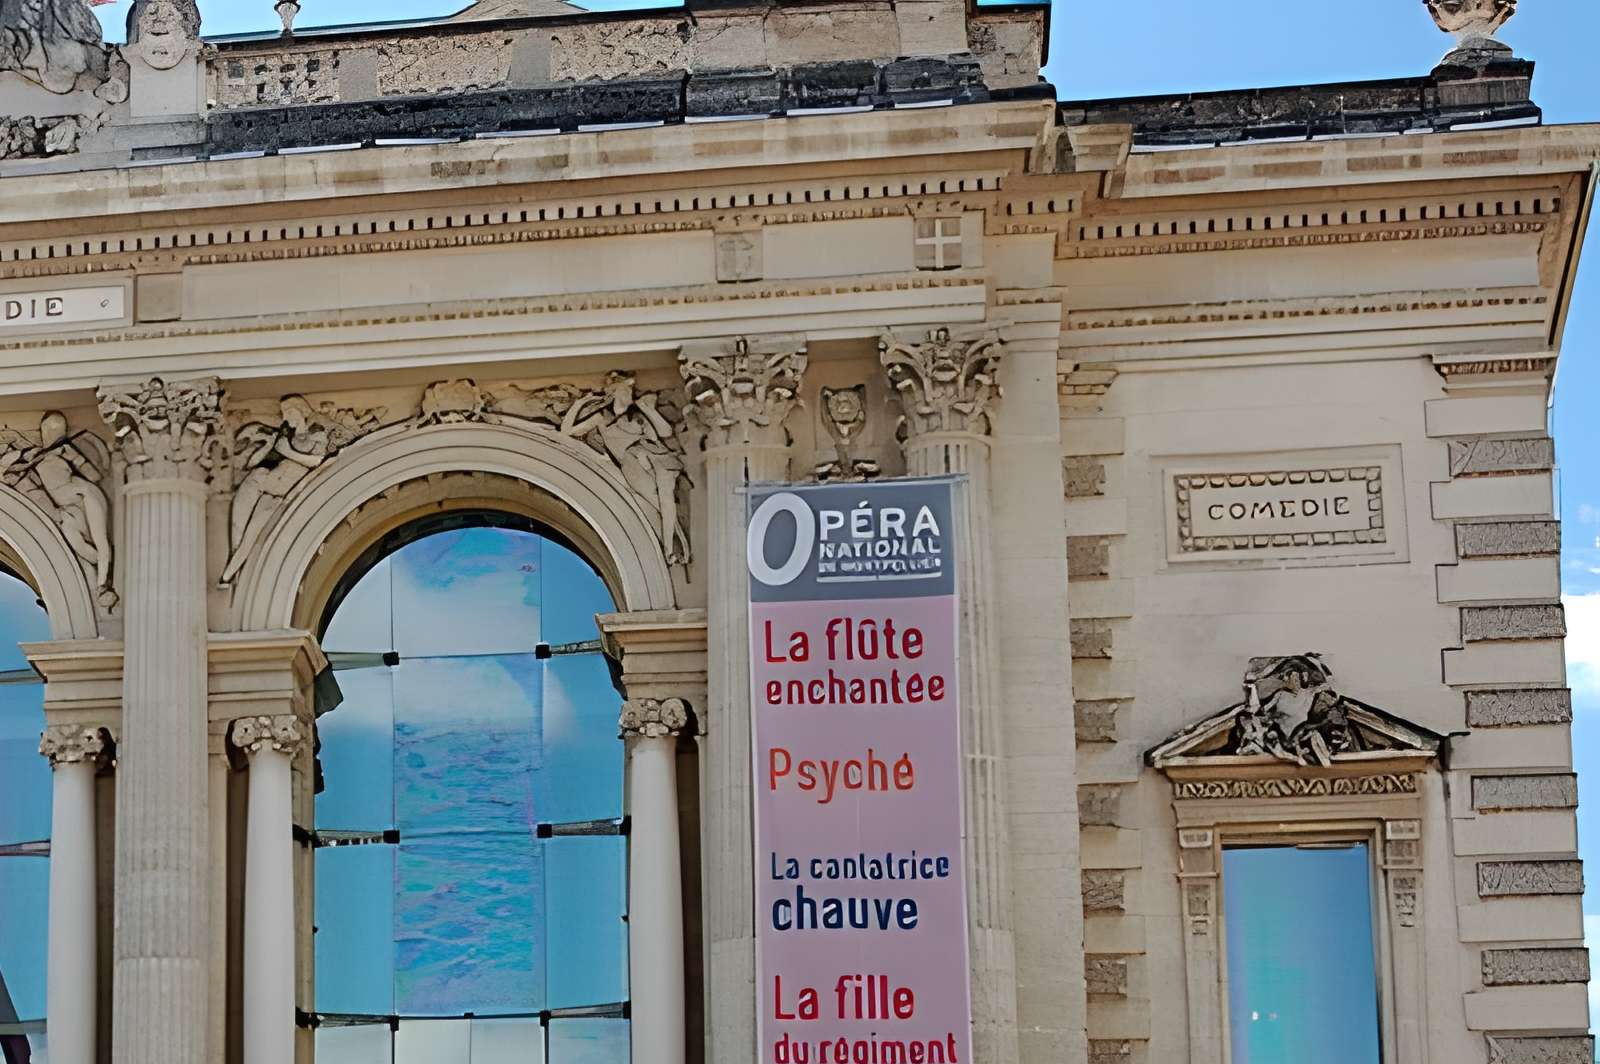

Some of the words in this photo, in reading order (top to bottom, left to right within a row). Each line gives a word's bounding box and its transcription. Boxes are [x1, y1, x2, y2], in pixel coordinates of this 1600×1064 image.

[1208, 496, 1350, 520] COMEDIE
[746, 492, 941, 587] OPÉRA
[819, 537, 942, 560] NATIONAL
[765, 620, 810, 663] La
[825, 617, 924, 661] flûte
[766, 668, 945, 705] enchantée
[769, 748, 915, 804] Psyché
[771, 852, 800, 881] La
[809, 850, 950, 881] cantatrice
[772, 884, 919, 931] chauve
[774, 975, 819, 1020] La
[833, 974, 915, 1020] fille
[774, 1032, 810, 1064] du
